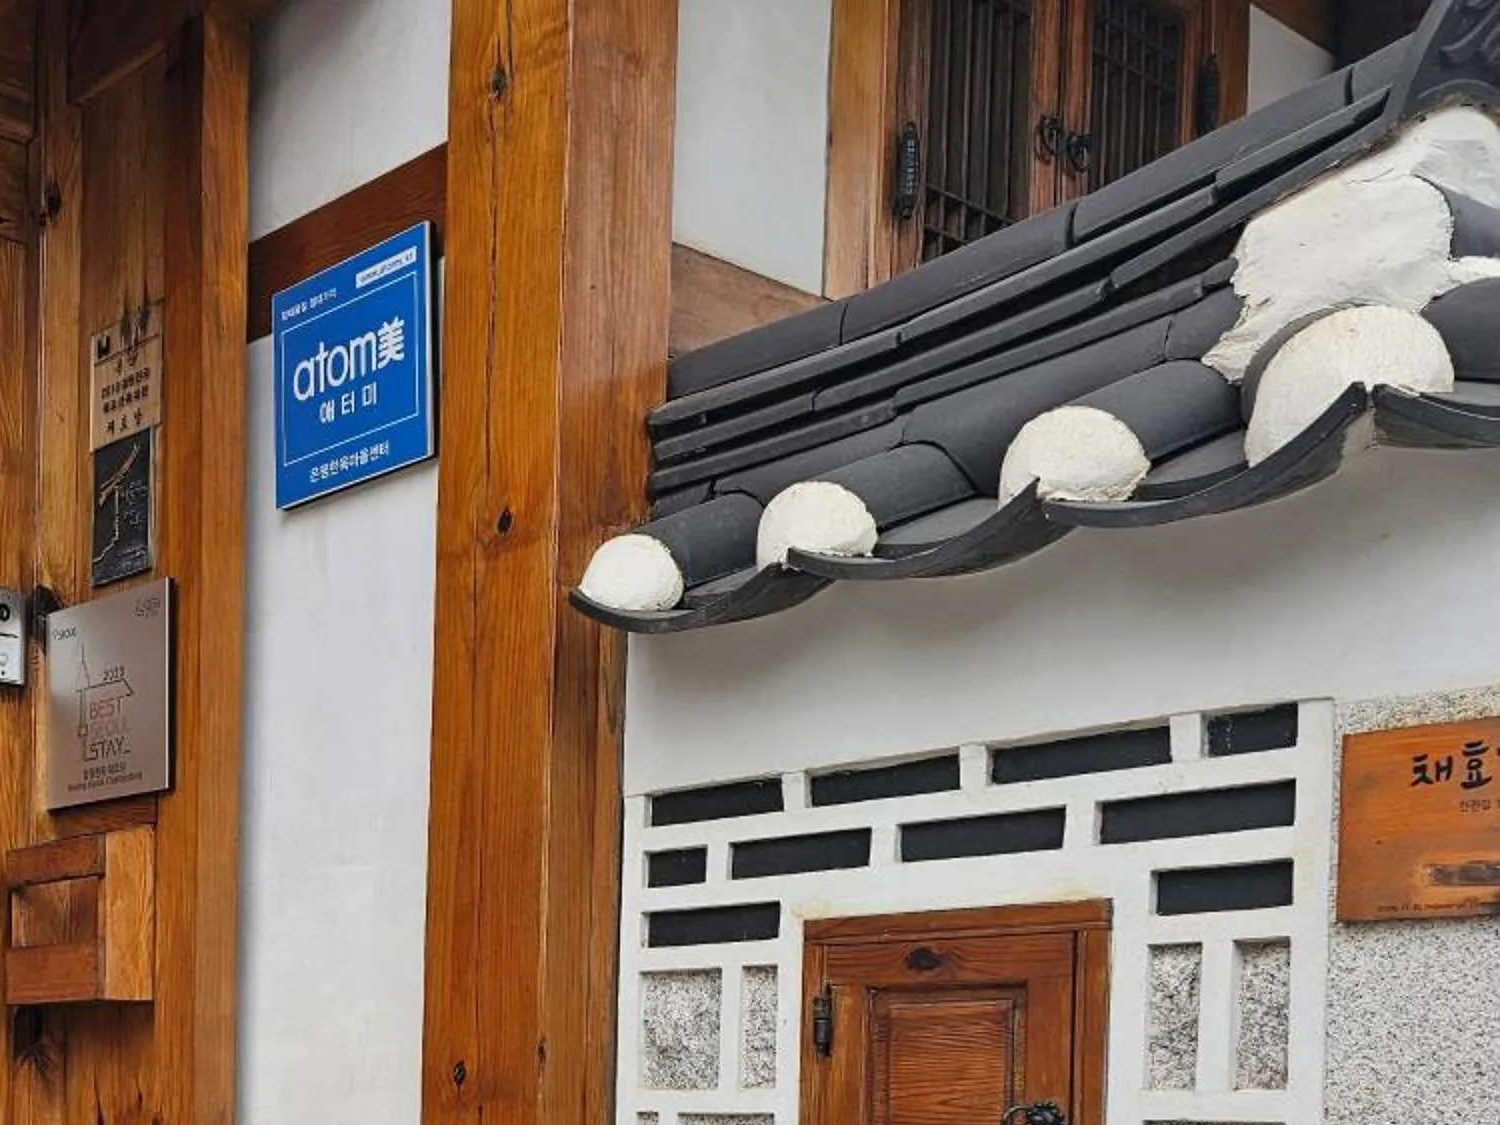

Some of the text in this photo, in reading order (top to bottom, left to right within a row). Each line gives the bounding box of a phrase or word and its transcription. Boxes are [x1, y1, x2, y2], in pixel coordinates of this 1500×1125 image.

[318, 381, 377, 424] 애터미
[89, 696, 124, 720] BEST
[1410, 740, 1500, 790] 채효
